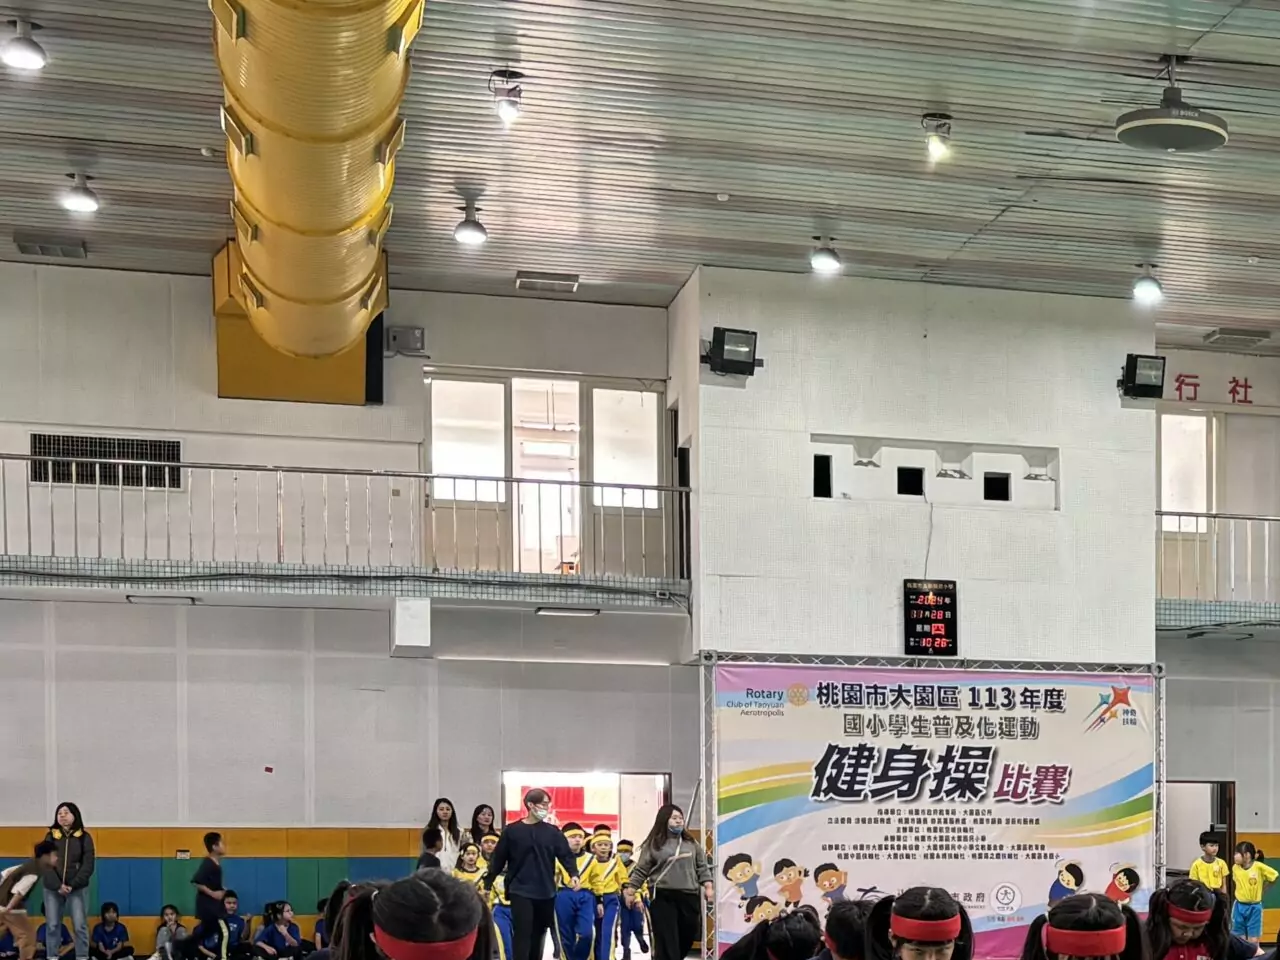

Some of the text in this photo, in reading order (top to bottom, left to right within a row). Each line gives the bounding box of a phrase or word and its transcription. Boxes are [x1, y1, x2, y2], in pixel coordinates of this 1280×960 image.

[746, 688, 784, 700] Rotary
[816, 682, 959, 710] 桃園市大園區
[755, 701, 785, 709] Taoyuan
[740, 709, 785, 717] Aerotropolis
[843, 715, 1039, 738] 國小學生普及化運動
